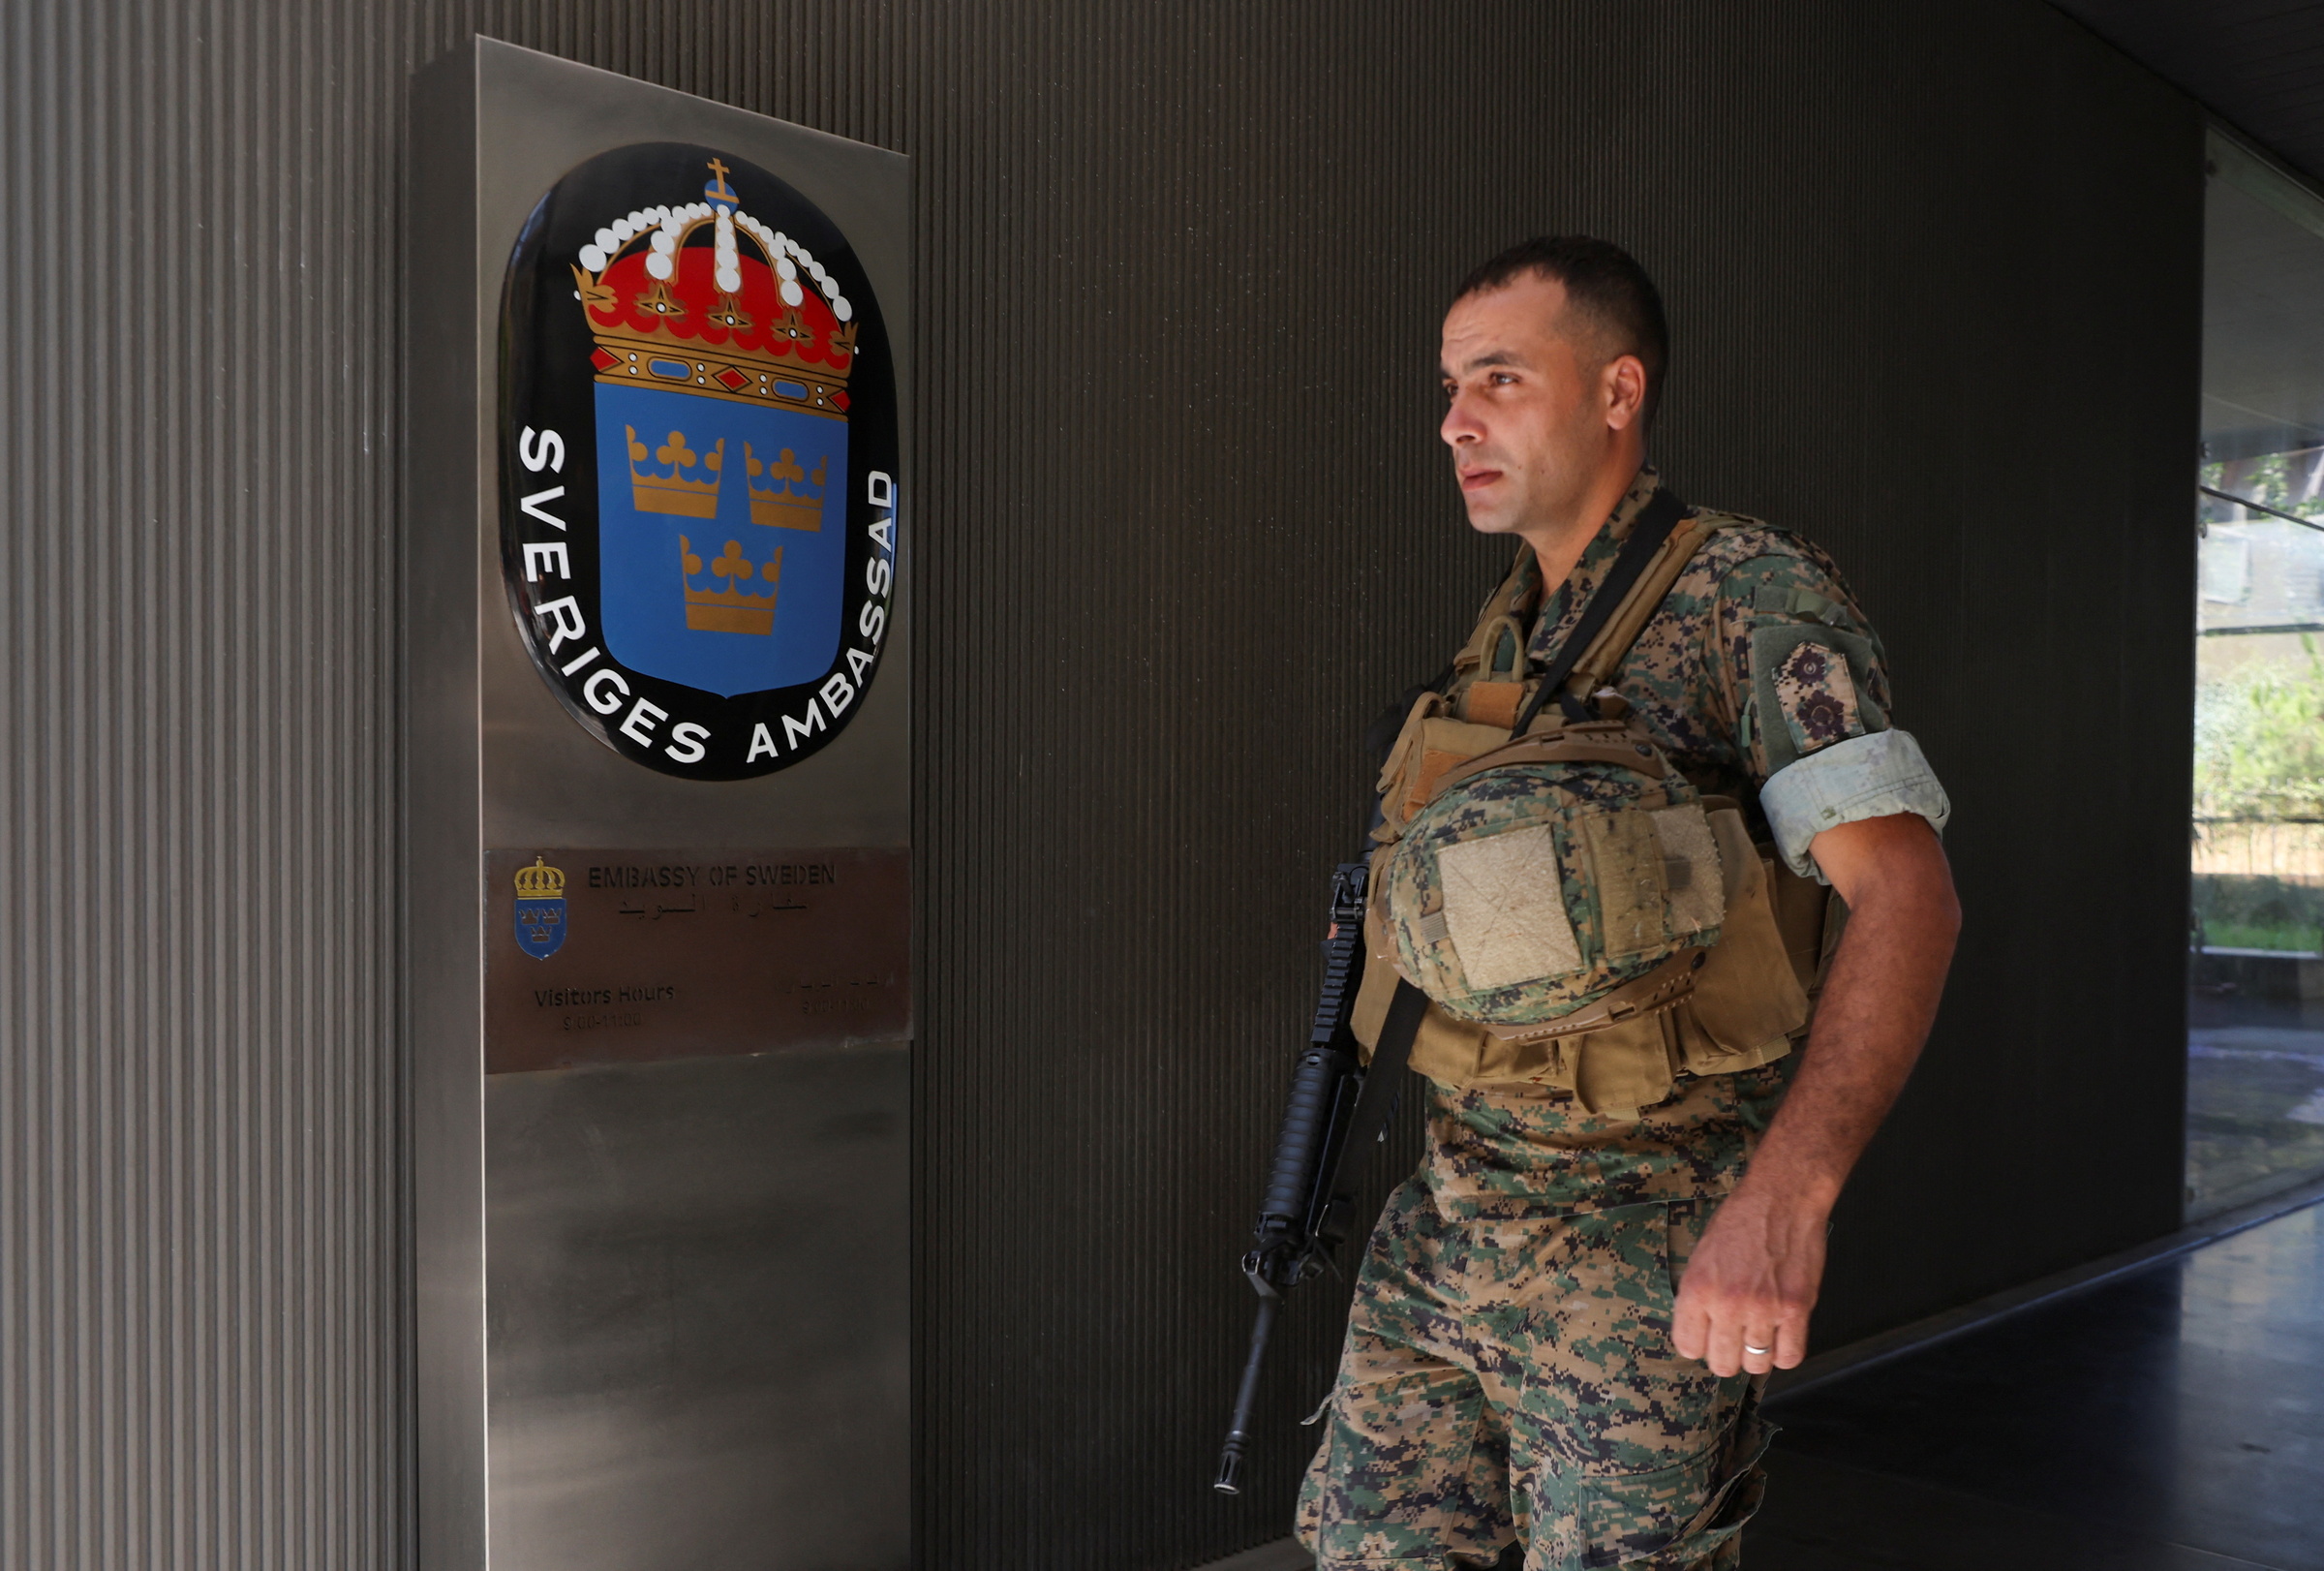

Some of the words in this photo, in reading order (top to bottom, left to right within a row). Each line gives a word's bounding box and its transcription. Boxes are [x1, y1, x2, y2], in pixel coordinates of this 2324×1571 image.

[519, 425, 712, 763] SVERIGES
[746, 470, 893, 763] AMBASSAD
[589, 866, 700, 888] EMBASSY
[709, 865, 738, 886] OF
[745, 864, 836, 885] SWEDEN
[535, 988, 612, 1007] Visitors
[619, 985, 675, 1003] Hours
